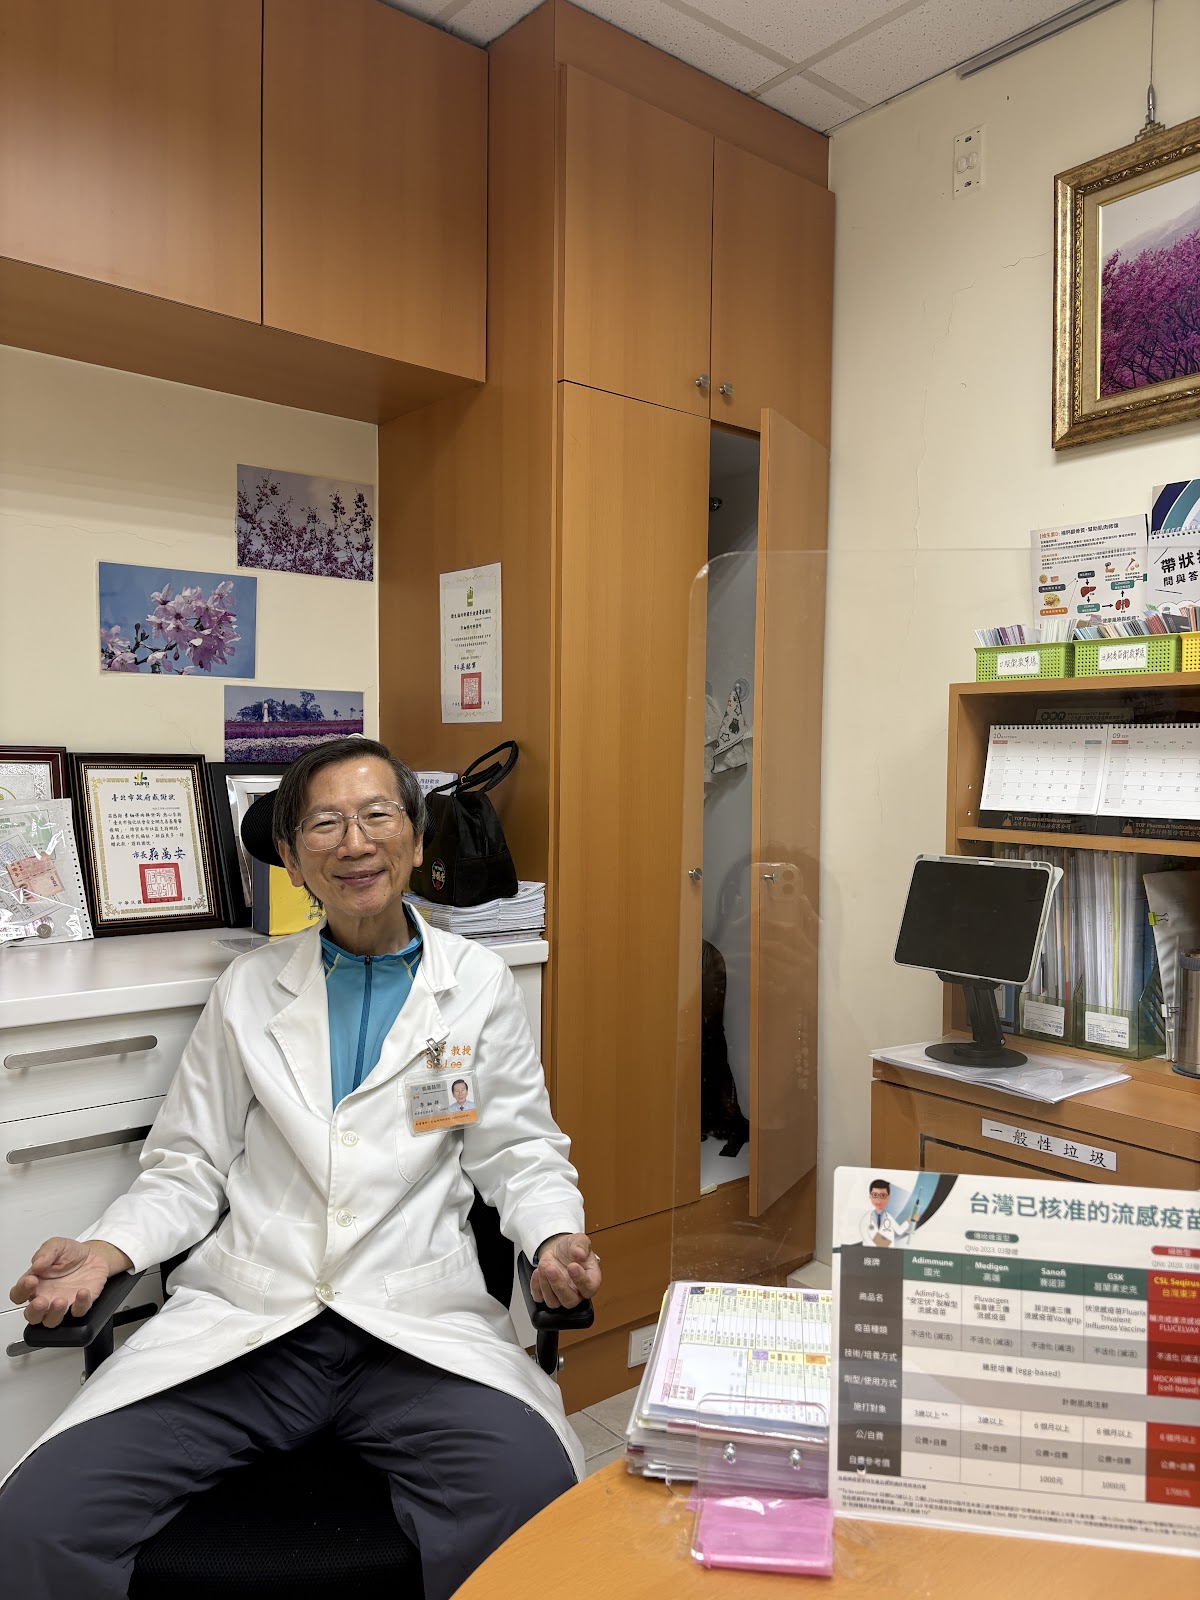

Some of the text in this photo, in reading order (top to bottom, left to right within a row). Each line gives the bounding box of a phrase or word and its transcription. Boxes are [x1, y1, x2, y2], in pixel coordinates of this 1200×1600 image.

[1161, 549, 1200, 574] 帶狀
[1163, 571, 1199, 587] 問與答
[451, 1045, 472, 1056] 教授
[989, 1128, 1106, 1168] 一般性垃圾
[912, 1256, 954, 1267] Adimmune
[974, 1261, 1009, 1272] Medigen
[923, 1267, 941, 1278] 國光
[1040, 1267, 1066, 1277] Sanofi
[1107, 1272, 1124, 1281] GSK
[1153, 1276, 1168, 1285] CSL
[858, 1291, 884, 1303] 商品名
[914, 1289, 950, 1299] AdimFlu-S
[1162, 1287, 1197, 1299] 台灣東洋
[917, 1306, 946, 1316] 流感疫苗
[1100, 1314, 1131, 1324] Trivalent
[854, 1323, 888, 1335] 疫苗種類
[1085, 1322, 1146, 1334] Influenza Vaccine
[844, 1348, 898, 1363] 技術/培養方式
[1015, 1367, 1061, 1378] (egg-based)
[853, 1401, 887, 1413] 施打對象
[855, 1428, 884, 1441] 公/自費
